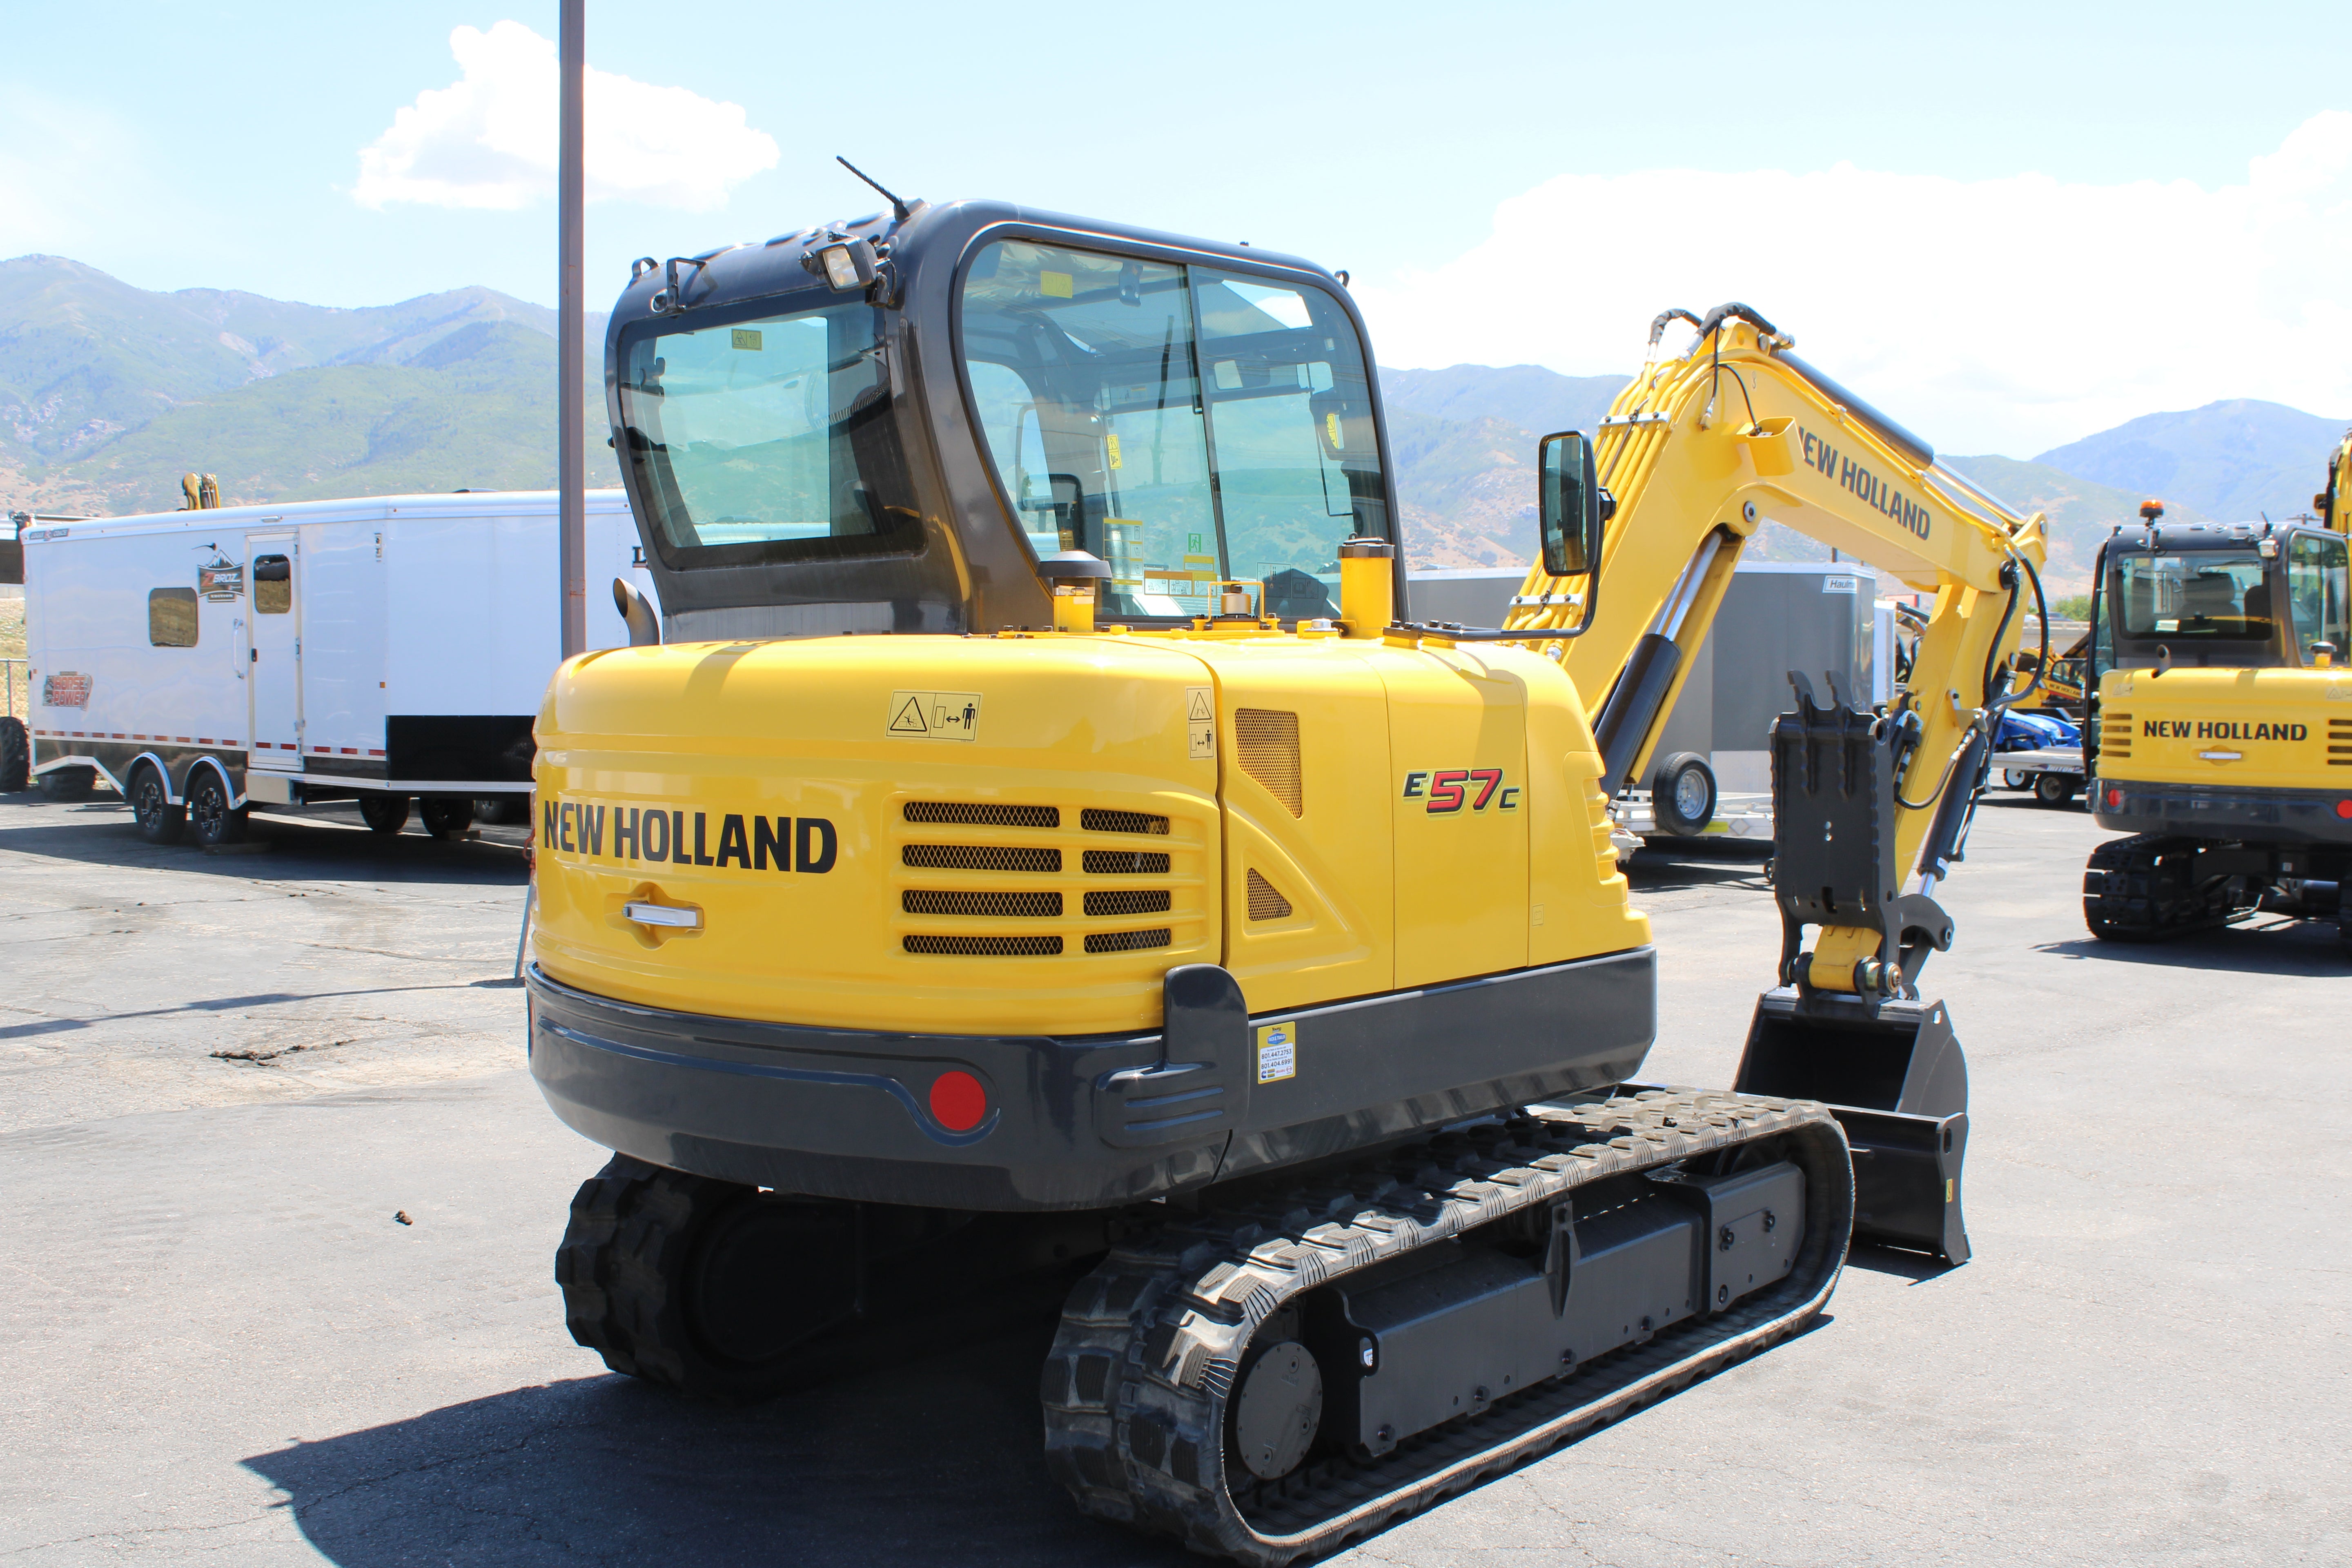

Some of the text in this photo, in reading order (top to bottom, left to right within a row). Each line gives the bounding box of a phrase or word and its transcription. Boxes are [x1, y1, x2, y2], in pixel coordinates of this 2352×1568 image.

[1840, 456, 1930, 541] HOLLAND
[53, 677, 85, 690] HORSE
[53, 691, 85, 706] POWER
[2144, 721, 2307, 741] NEW HOLLAND
[545, 801, 837, 873] NEW HOLLAND
[1261, 1048, 1292, 1059] 801.447.2753
[1261, 1058, 1292, 1069] 801.404.6991
